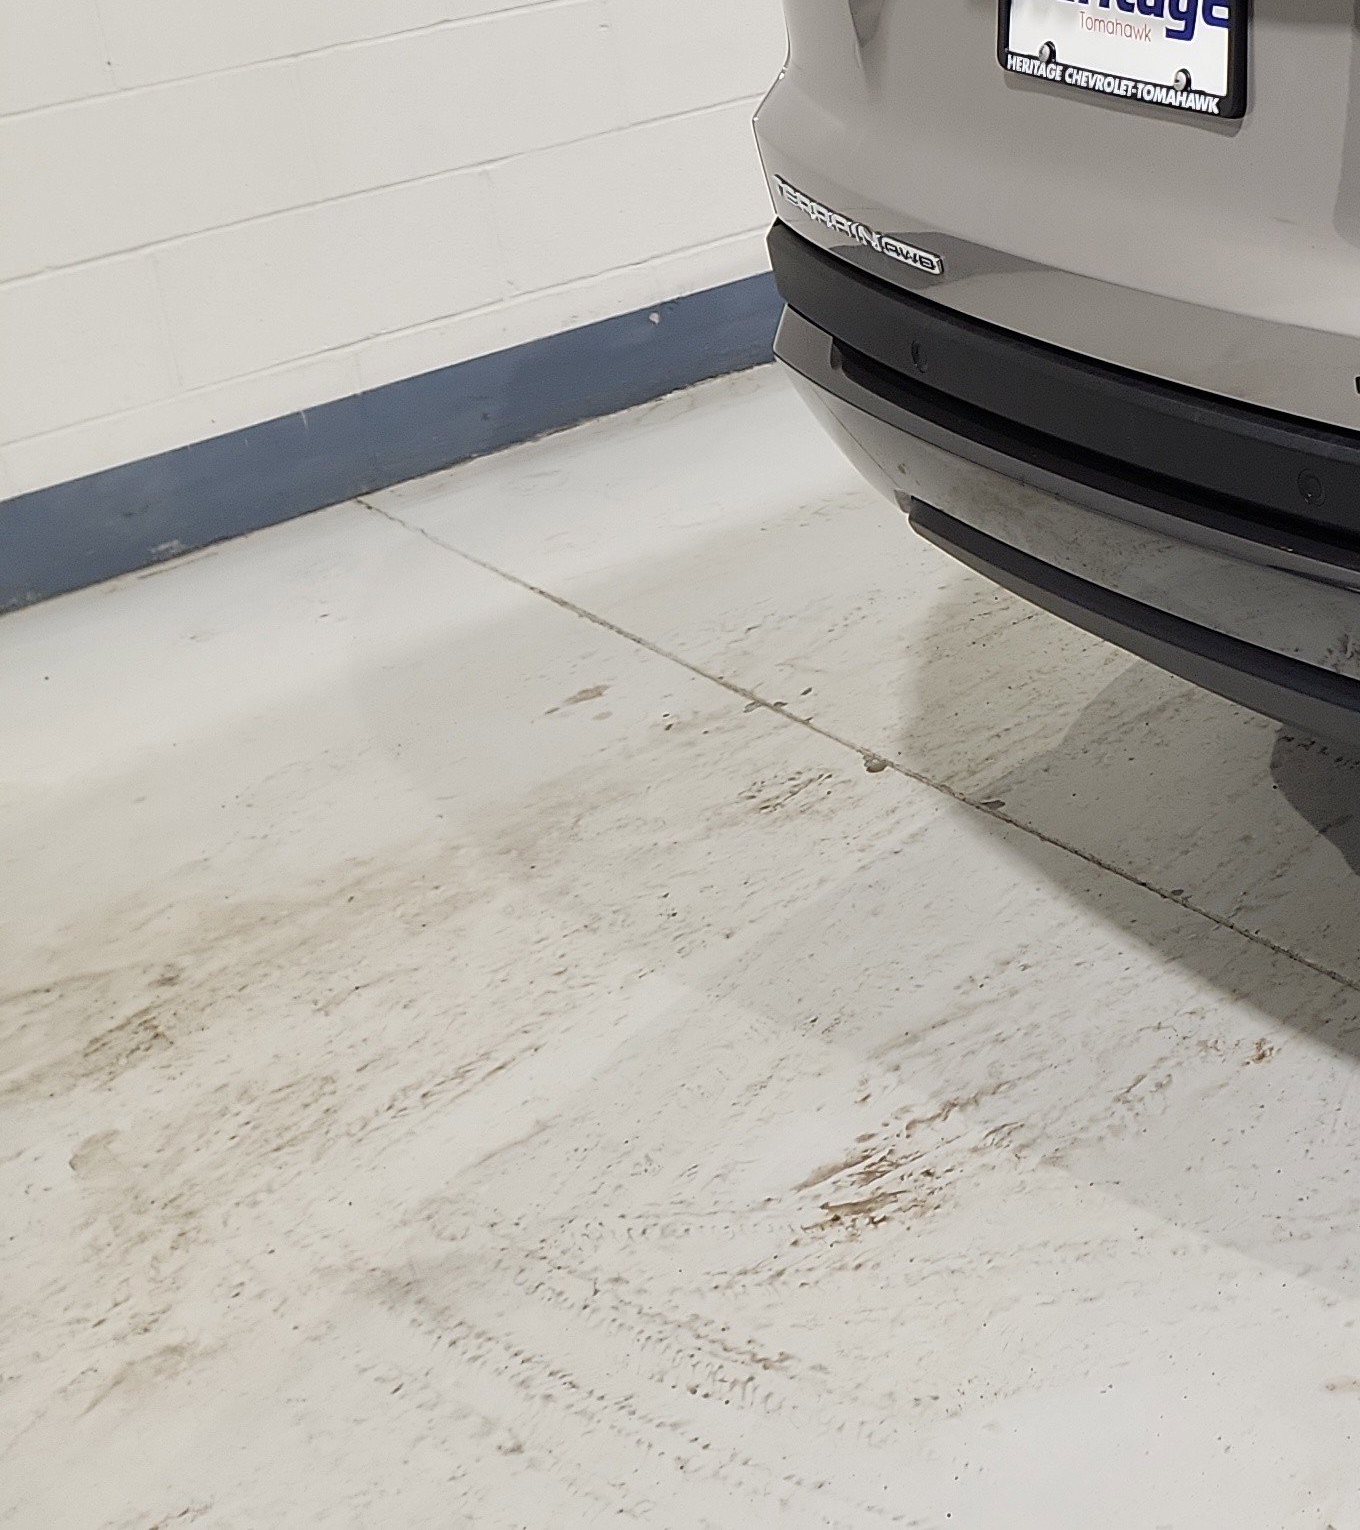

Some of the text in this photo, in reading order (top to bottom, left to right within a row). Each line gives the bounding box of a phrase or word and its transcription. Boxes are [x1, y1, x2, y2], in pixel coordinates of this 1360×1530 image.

[1079, 10, 1152, 43] Tomahawk
[1006, 54, 1220, 115] HERITAGE CHEVROLET-TOMAHAWK
